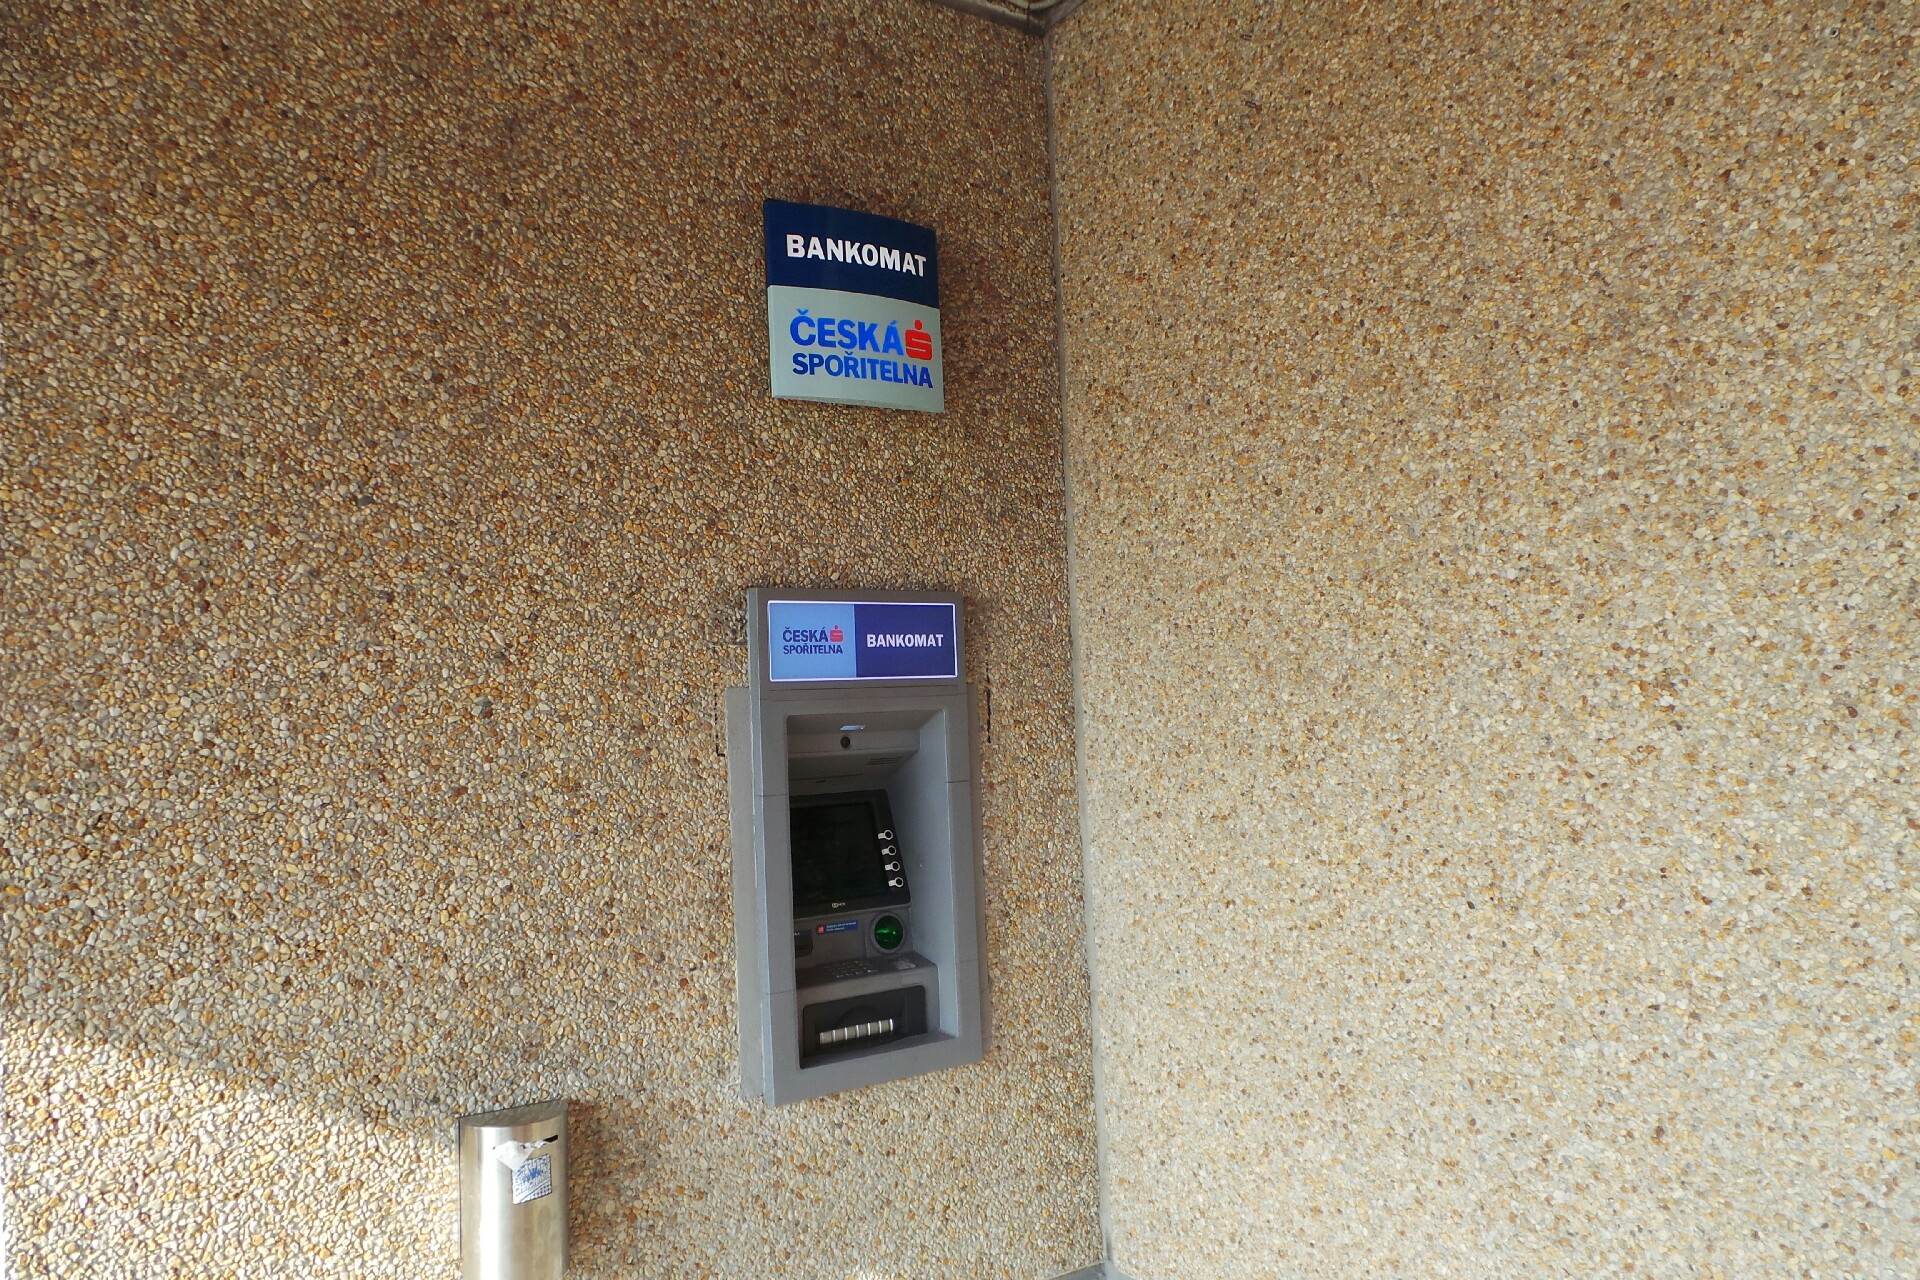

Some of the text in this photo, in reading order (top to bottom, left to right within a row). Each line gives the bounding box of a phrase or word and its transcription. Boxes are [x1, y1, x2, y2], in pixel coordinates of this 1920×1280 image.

[786, 233, 927, 277] BANKOMAT
[789, 308, 904, 356] ČESKÁ
[792, 351, 933, 389] SPOŘITELNA
[782, 626, 829, 643] ČESKÁ
[866, 633, 944, 648] BANKOMAT
[783, 643, 843, 655] SPOŘITELNA
